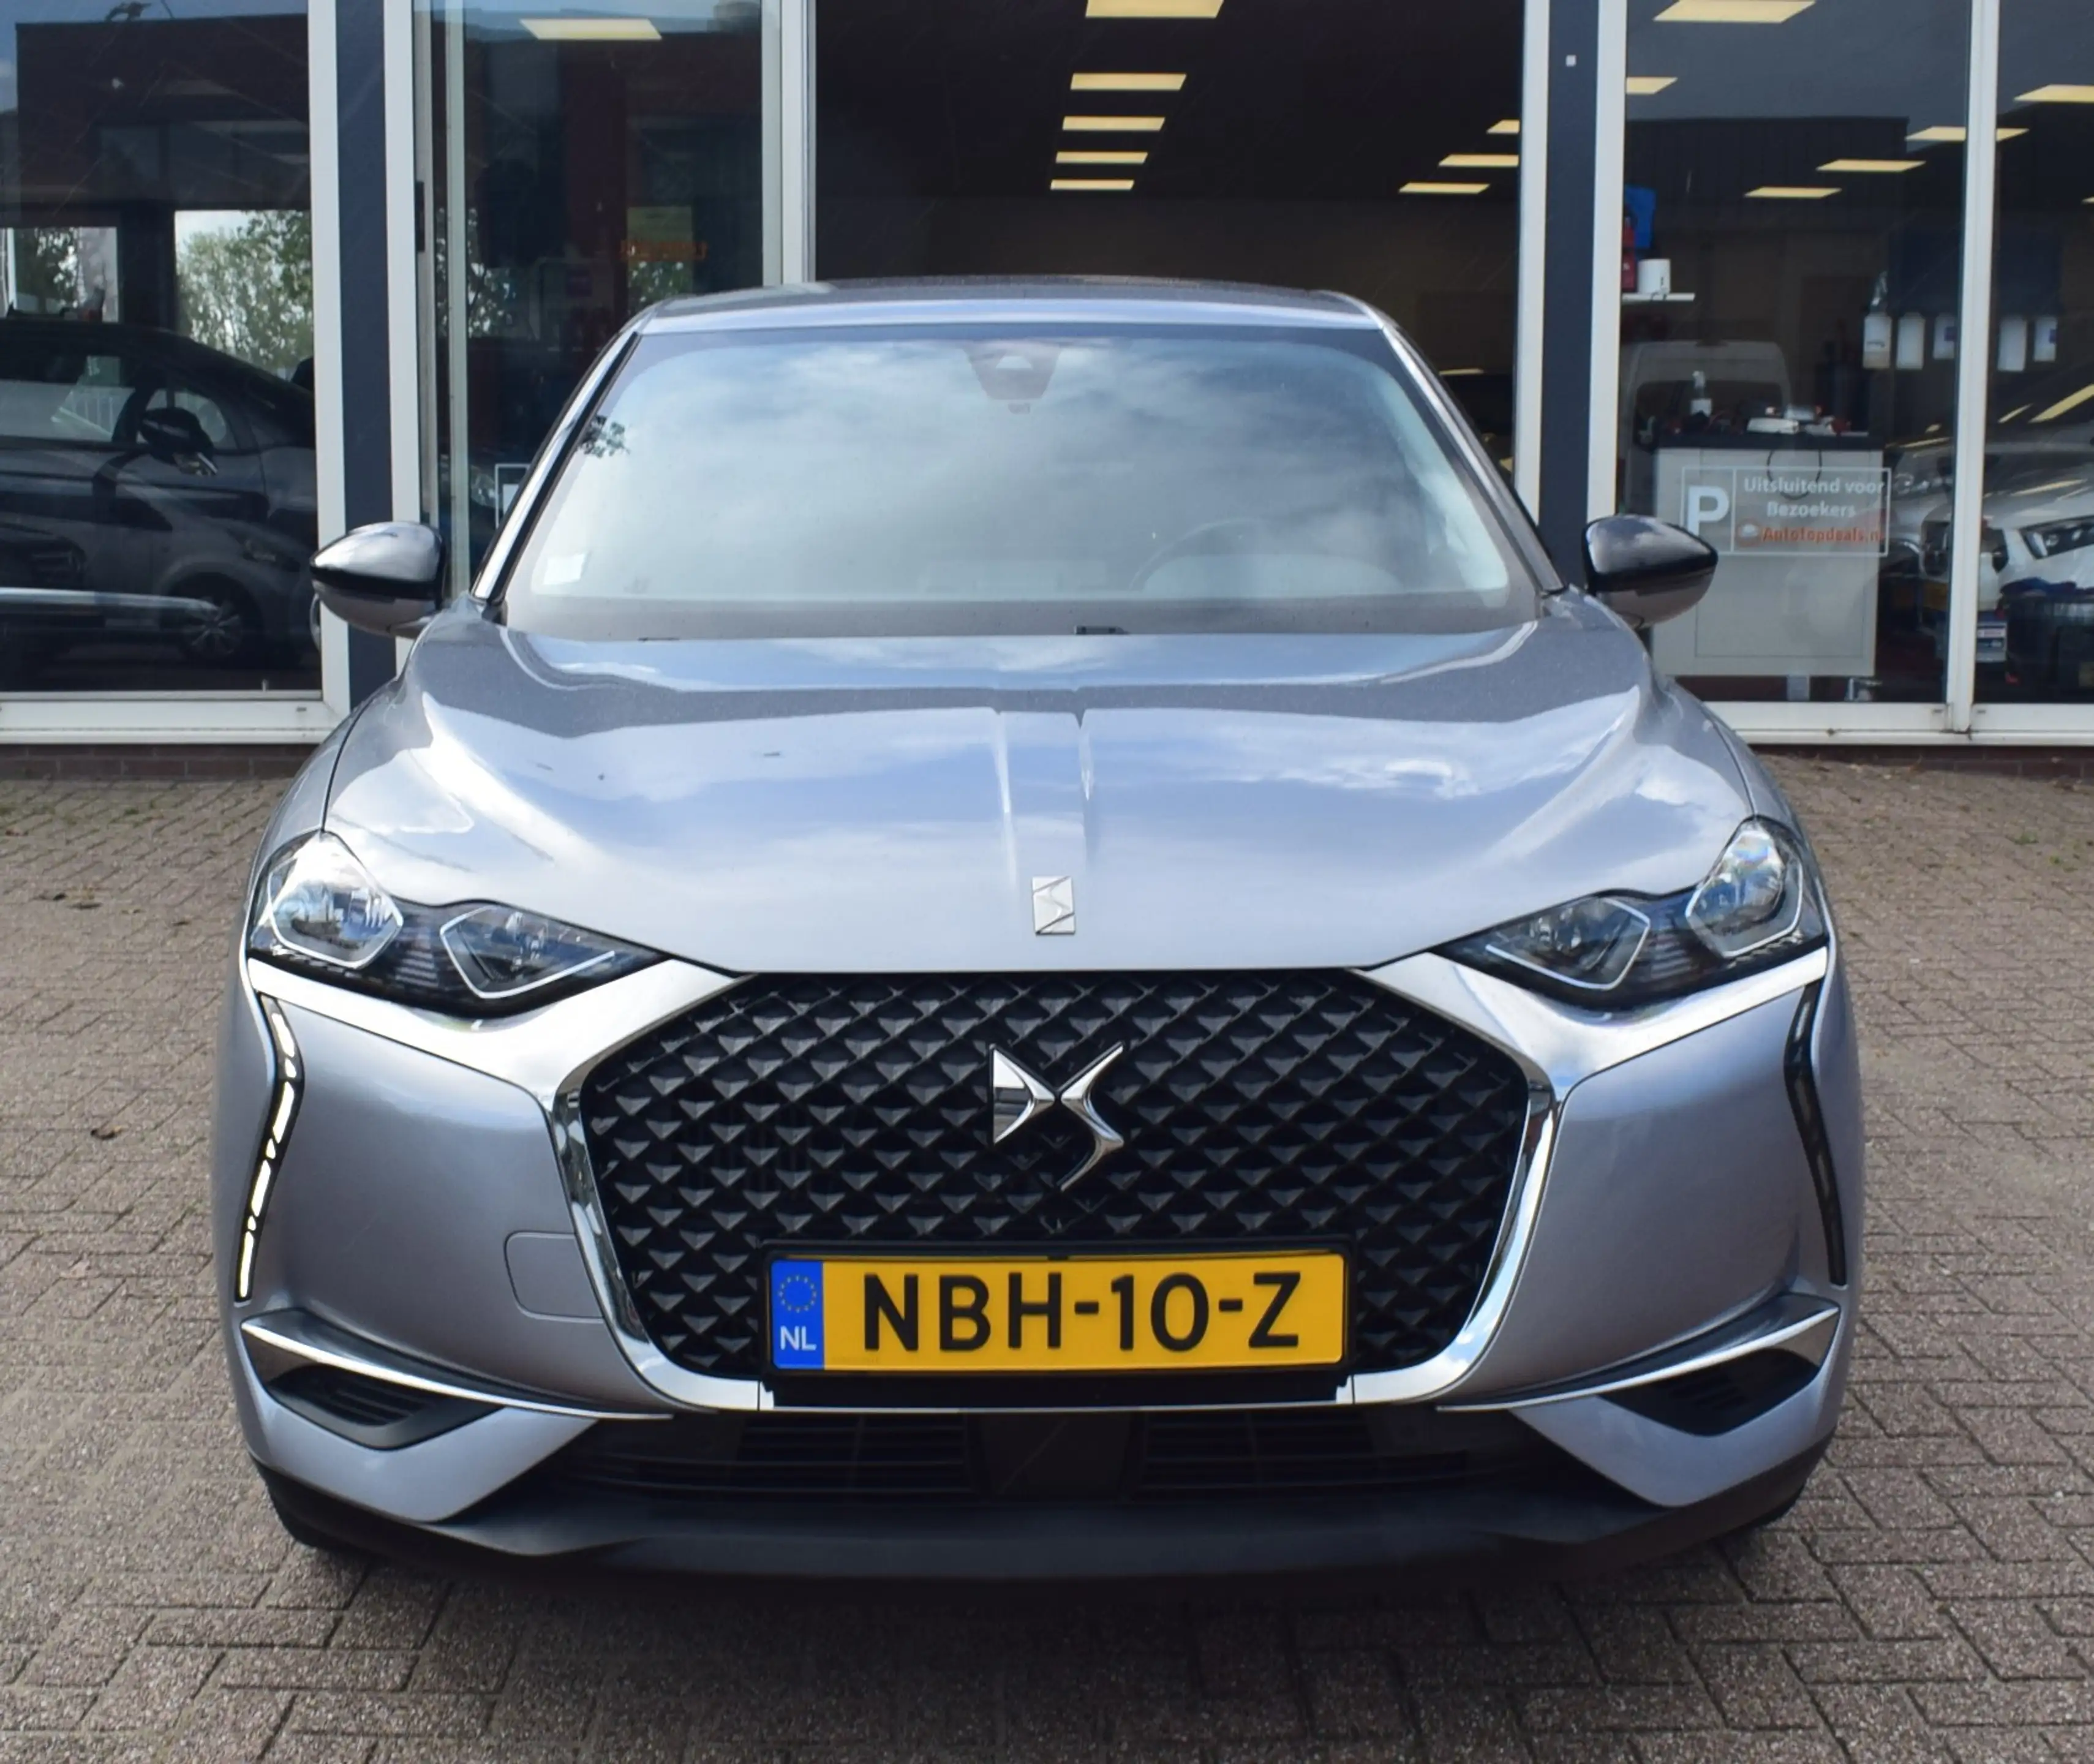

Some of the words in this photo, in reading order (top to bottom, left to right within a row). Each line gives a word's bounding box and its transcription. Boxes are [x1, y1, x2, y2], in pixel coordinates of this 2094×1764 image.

[1744, 477, 1840, 494] Uitsluitend
[1844, 480, 1884, 494] voor
[1687, 485, 1729, 537] P
[1766, 500, 1856, 518] Bezoekers
[864, 1272, 1301, 1352] NBH-10-Z
[780, 1325, 817, 1351] NL
